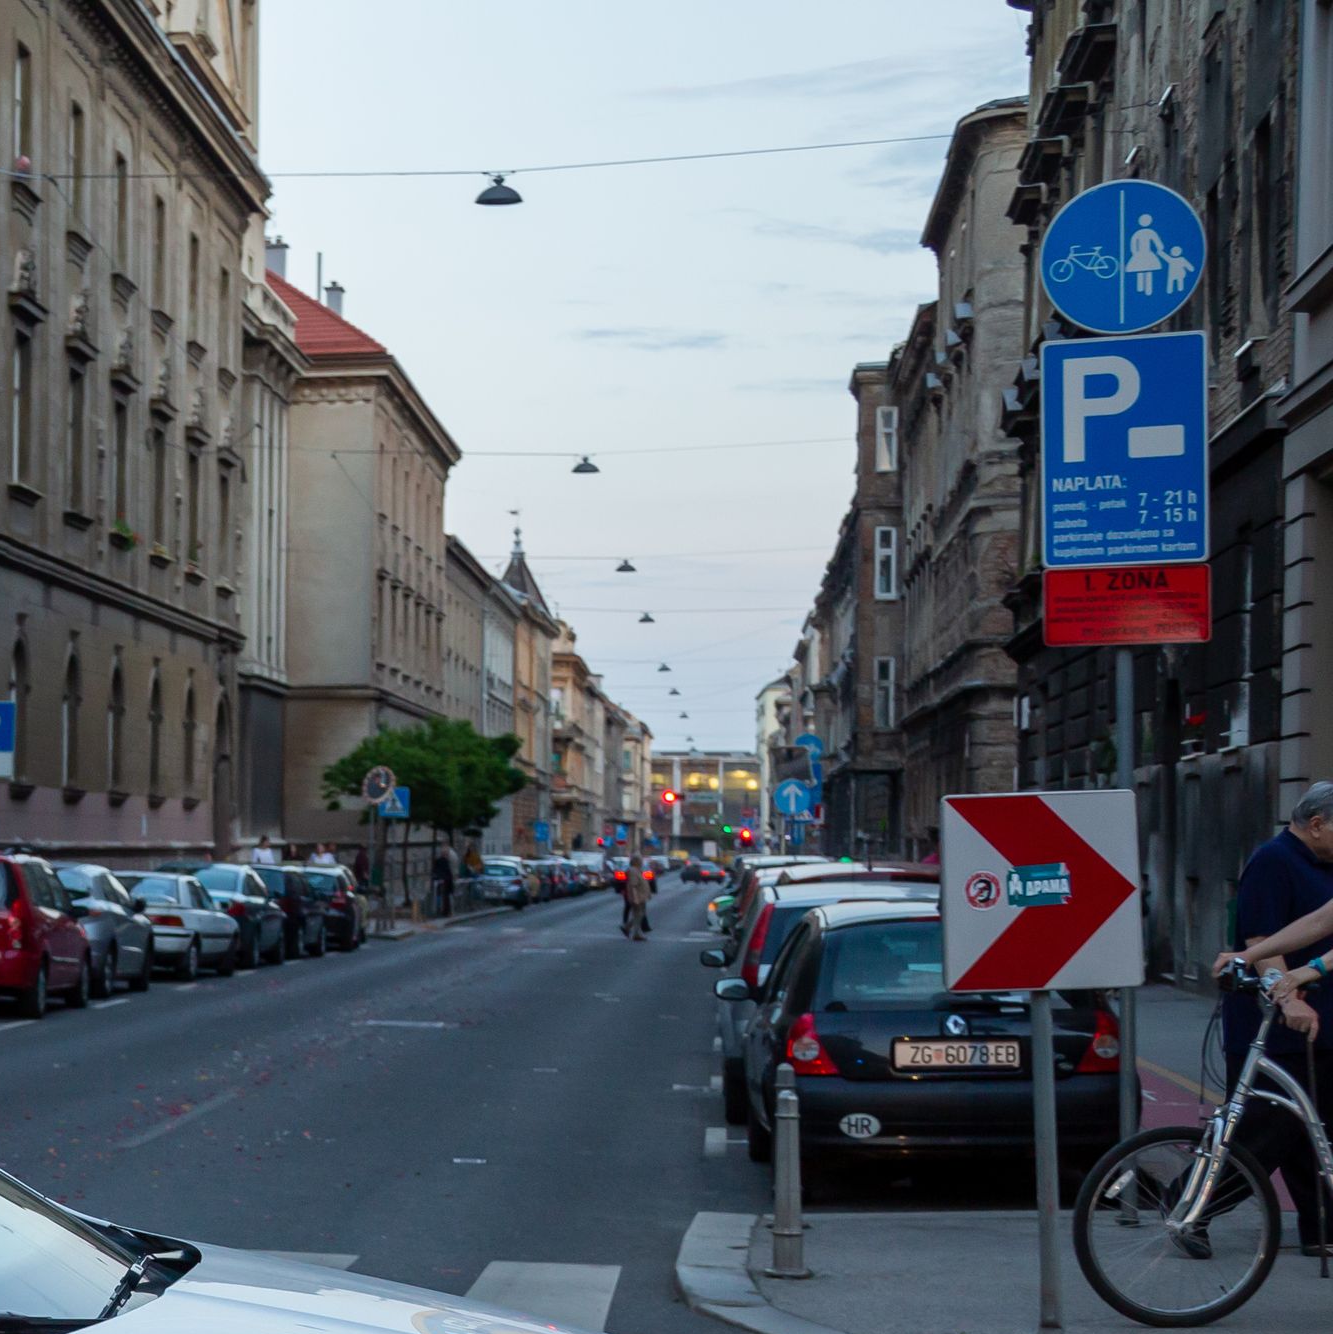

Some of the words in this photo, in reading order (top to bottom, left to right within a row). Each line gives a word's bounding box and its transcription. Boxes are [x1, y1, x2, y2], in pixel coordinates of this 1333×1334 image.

[1062, 355, 1141, 463] P
[1052, 475, 1127, 492] NAPLATA:
[1138, 492, 1148, 506] 7
[1164, 490, 1182, 505] 21
[1188, 490, 1197, 504] h
[1138, 510, 1148, 524] 7
[1163, 508, 1182, 522] 15
[1188, 508, 1197, 522] h
[1107, 570, 1170, 591] ZONA
[910, 1046, 932, 1064] ZG
[847, 1118, 872, 1135] HR
